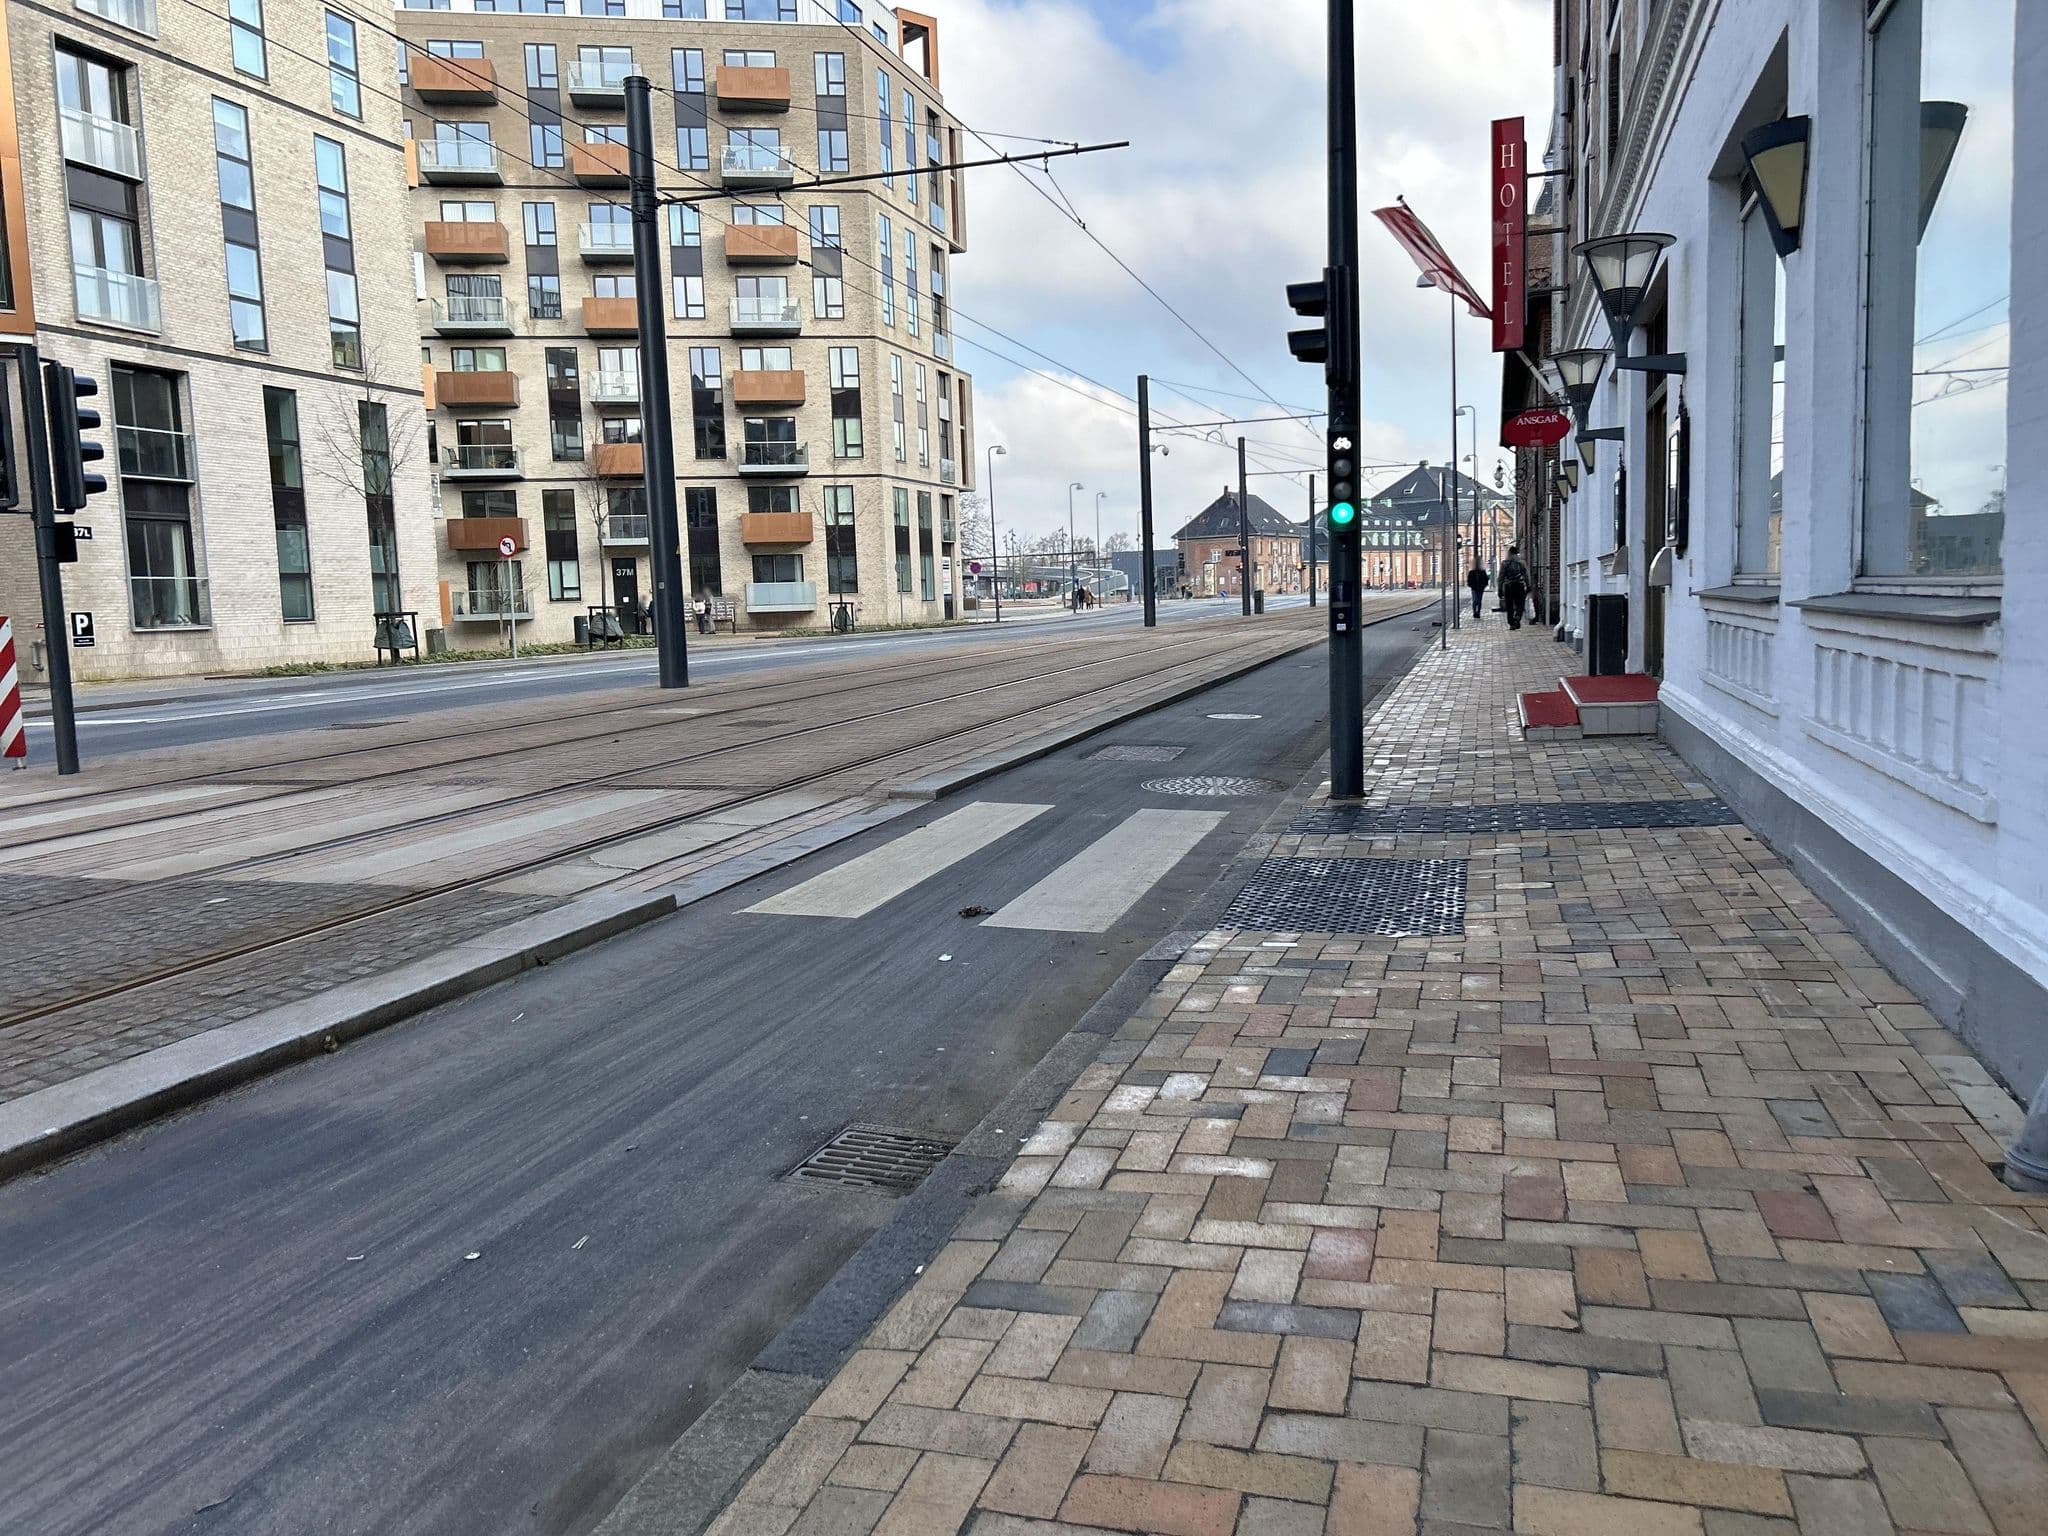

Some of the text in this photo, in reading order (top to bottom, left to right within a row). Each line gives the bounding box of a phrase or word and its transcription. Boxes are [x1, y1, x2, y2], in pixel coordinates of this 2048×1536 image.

[1500, 143, 1516, 325] HOTEL
[1516, 415, 1558, 426] ANSGAR
[616, 568, 634, 577] 37M
[75, 614, 89, 635] P
